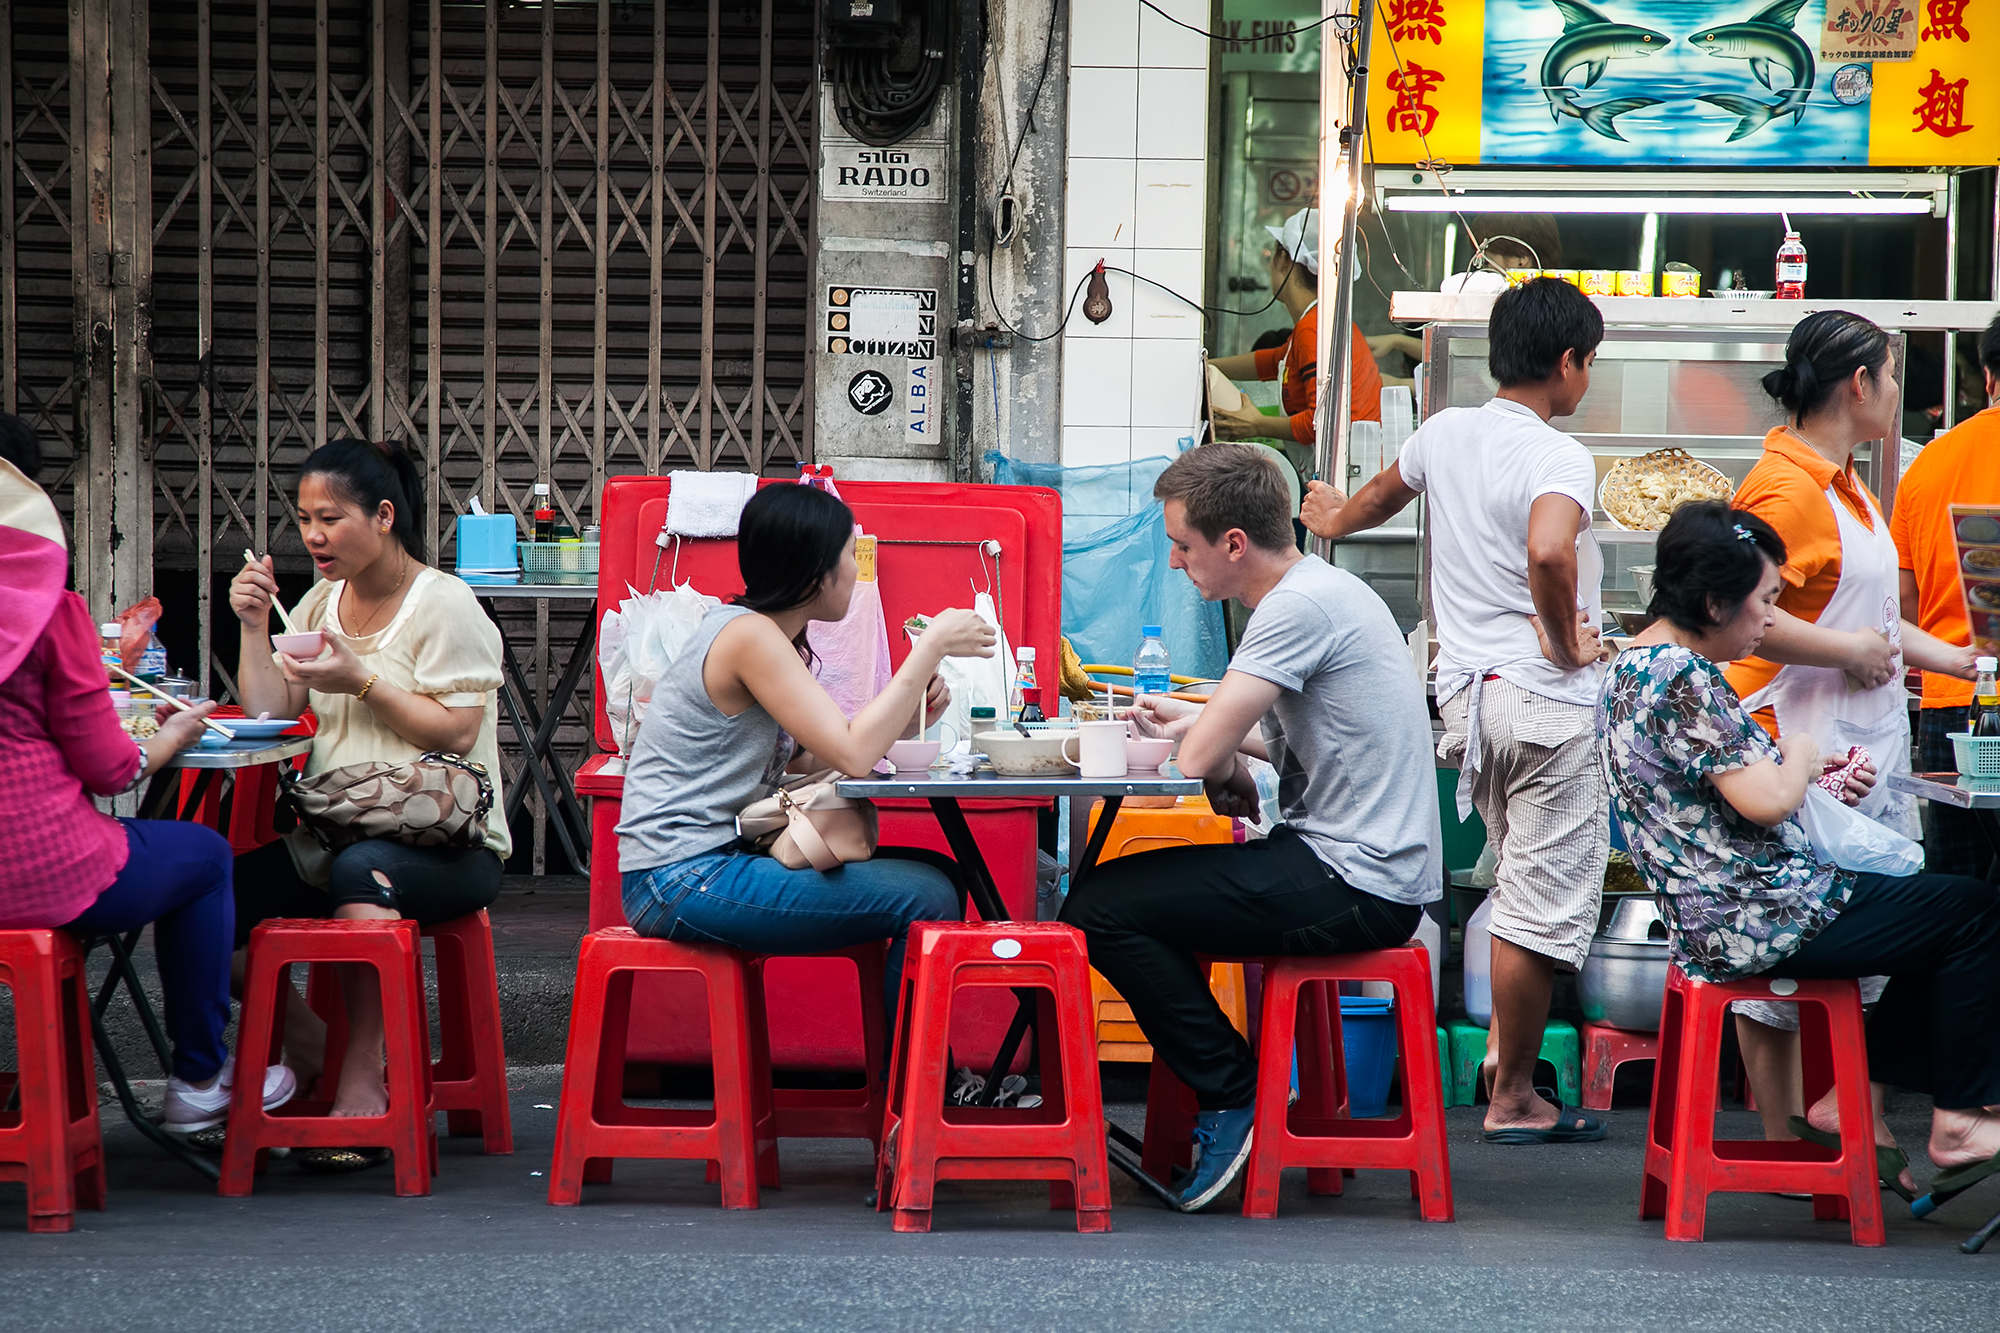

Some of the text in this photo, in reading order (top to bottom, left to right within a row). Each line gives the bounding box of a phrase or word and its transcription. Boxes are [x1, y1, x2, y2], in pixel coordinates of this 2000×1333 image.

[838, 166, 930, 188] RADO
[861, 188, 908, 197] Switzerland
[849, 340, 932, 358] CITIZEN
[910, 365, 927, 434] ALBA
